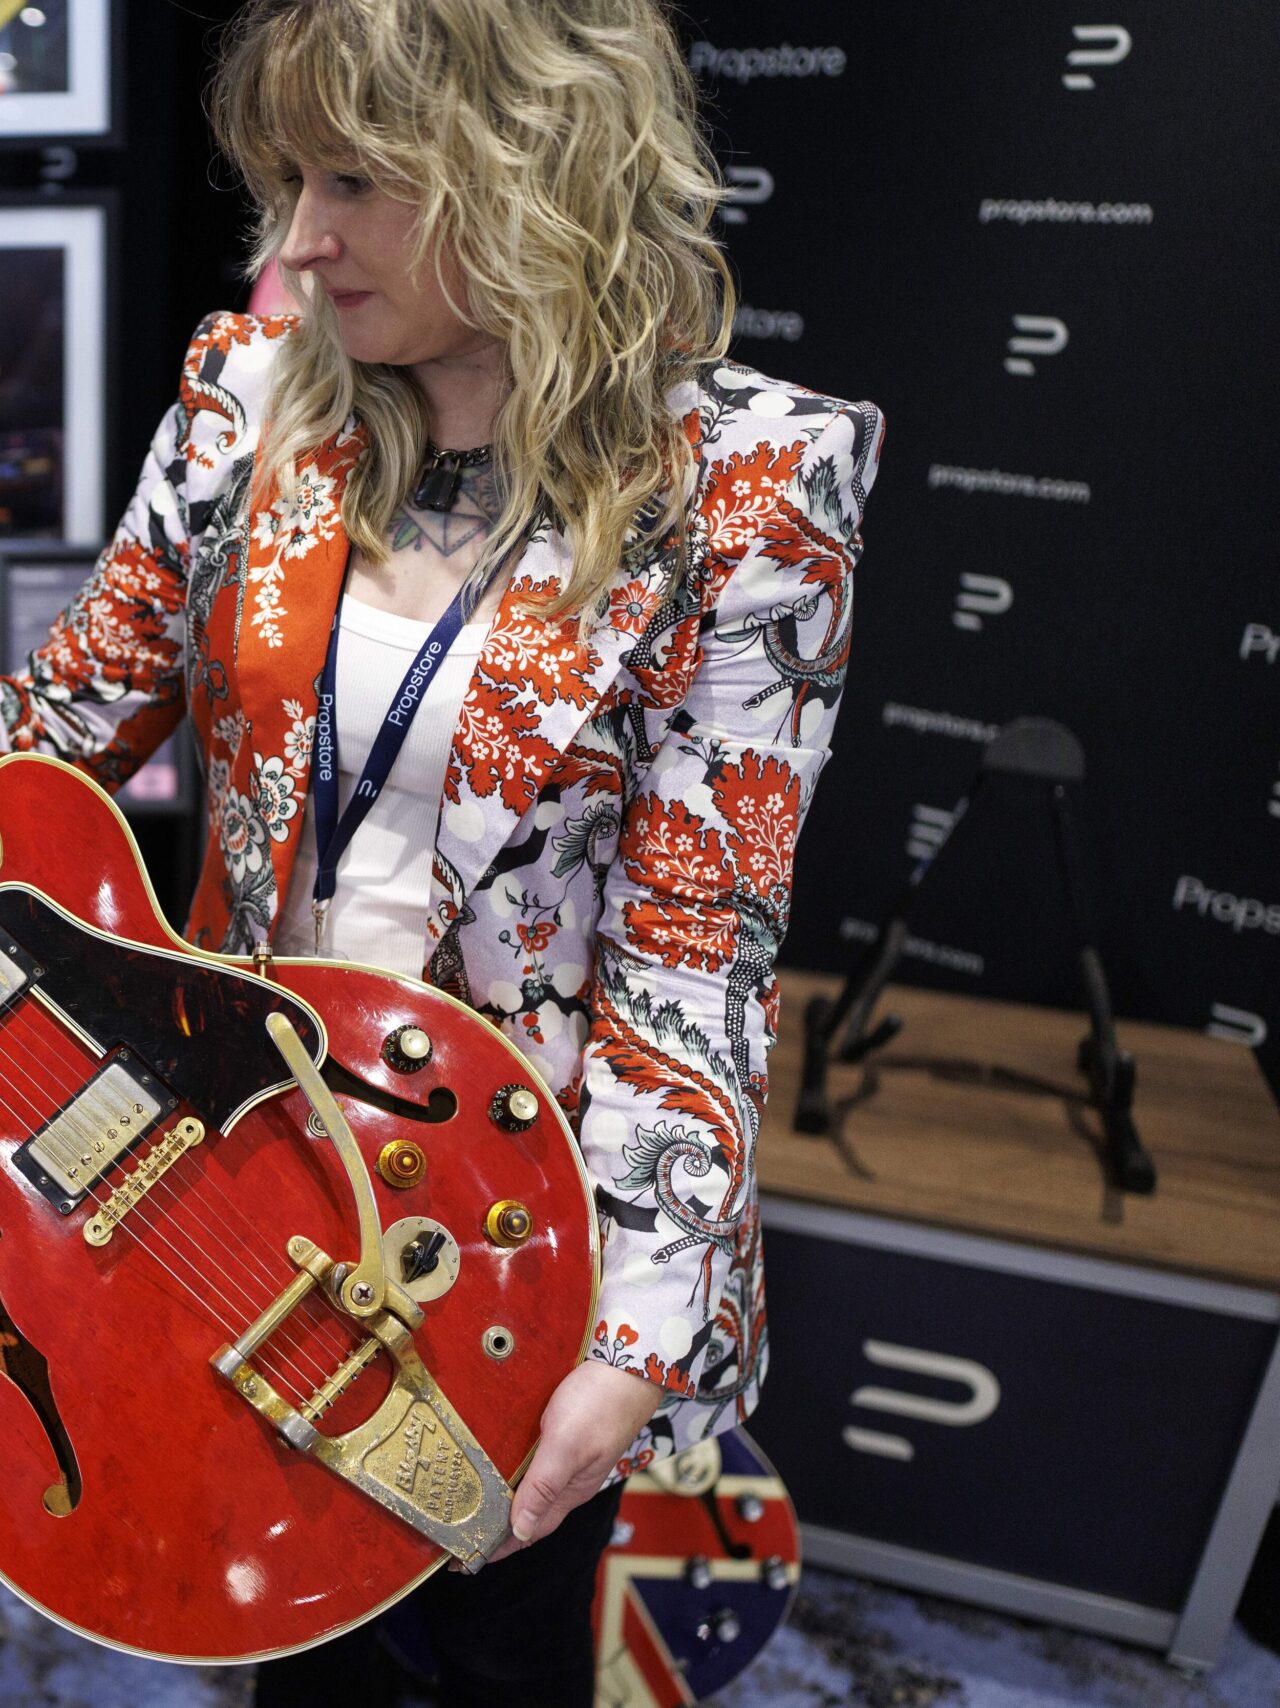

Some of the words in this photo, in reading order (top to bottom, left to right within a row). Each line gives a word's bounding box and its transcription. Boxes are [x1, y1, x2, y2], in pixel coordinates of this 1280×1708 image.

[690, 41, 847, 85] Propstore
[978, 197, 1154, 225] propstore.com
[387, 641, 442, 726] Propstore
[315, 694, 334, 781] Propstore
[426, 1438, 449, 1511] PATENT
